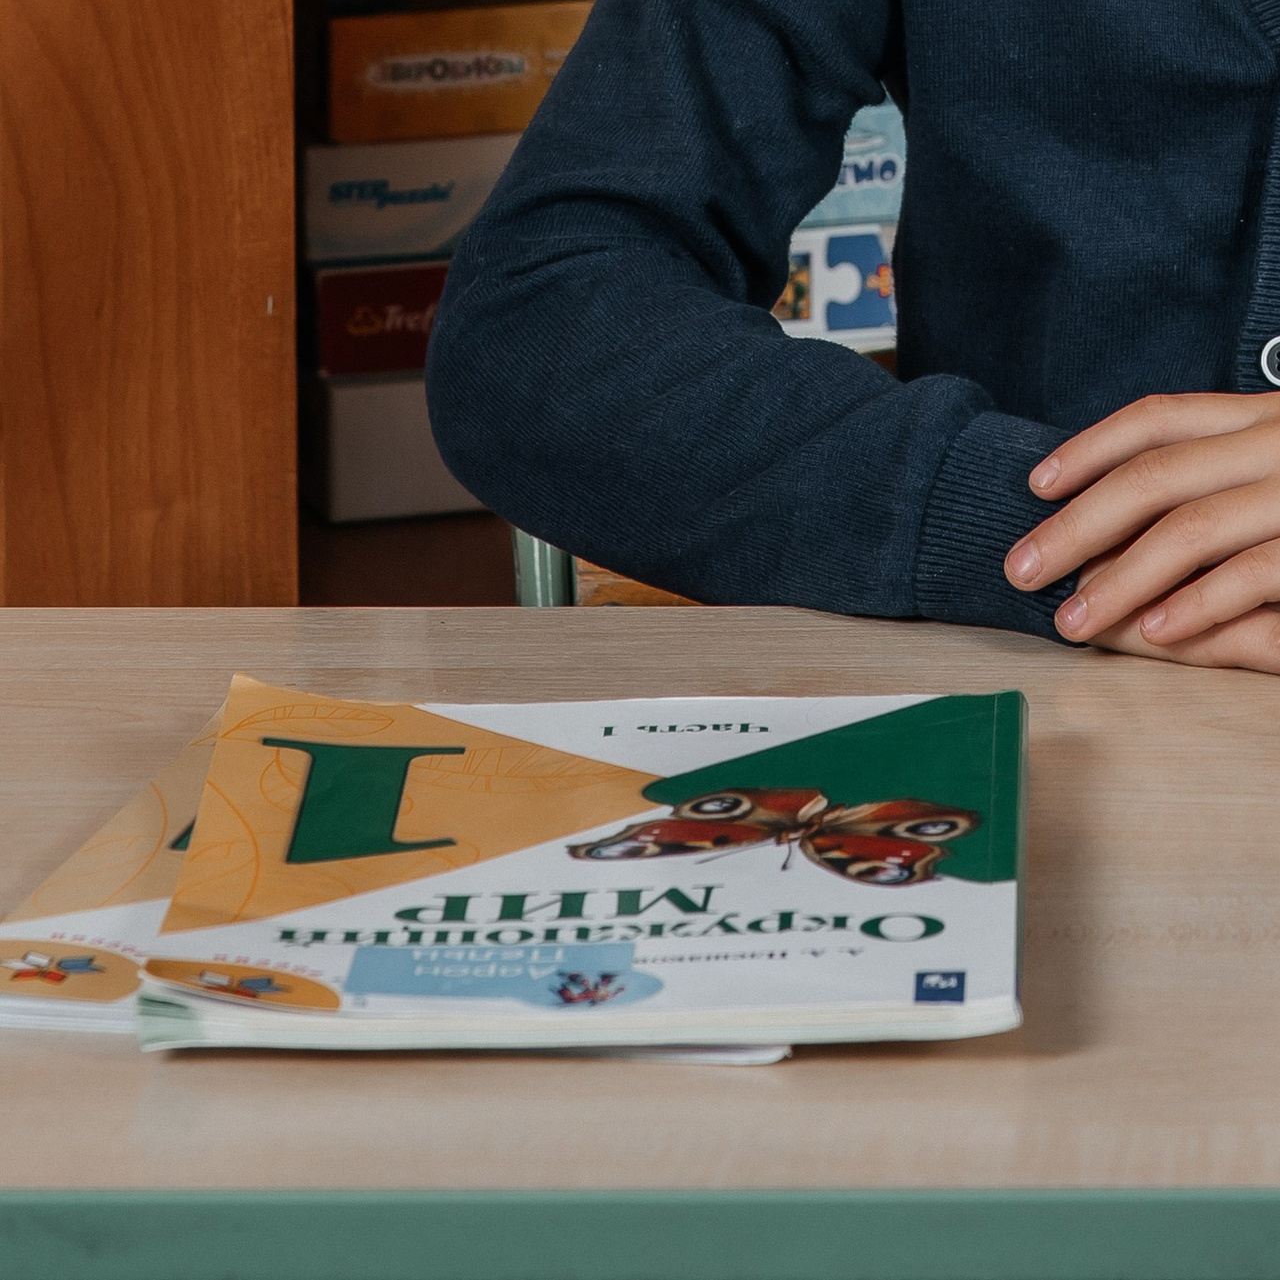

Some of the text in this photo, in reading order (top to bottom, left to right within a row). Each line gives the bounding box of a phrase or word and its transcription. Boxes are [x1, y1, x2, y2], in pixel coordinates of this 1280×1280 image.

[636, 722, 772, 735] Часть
[262, 738, 465, 866] 1
[392, 884, 726, 927] МИР
[276, 910, 947, 951] Окружающий
